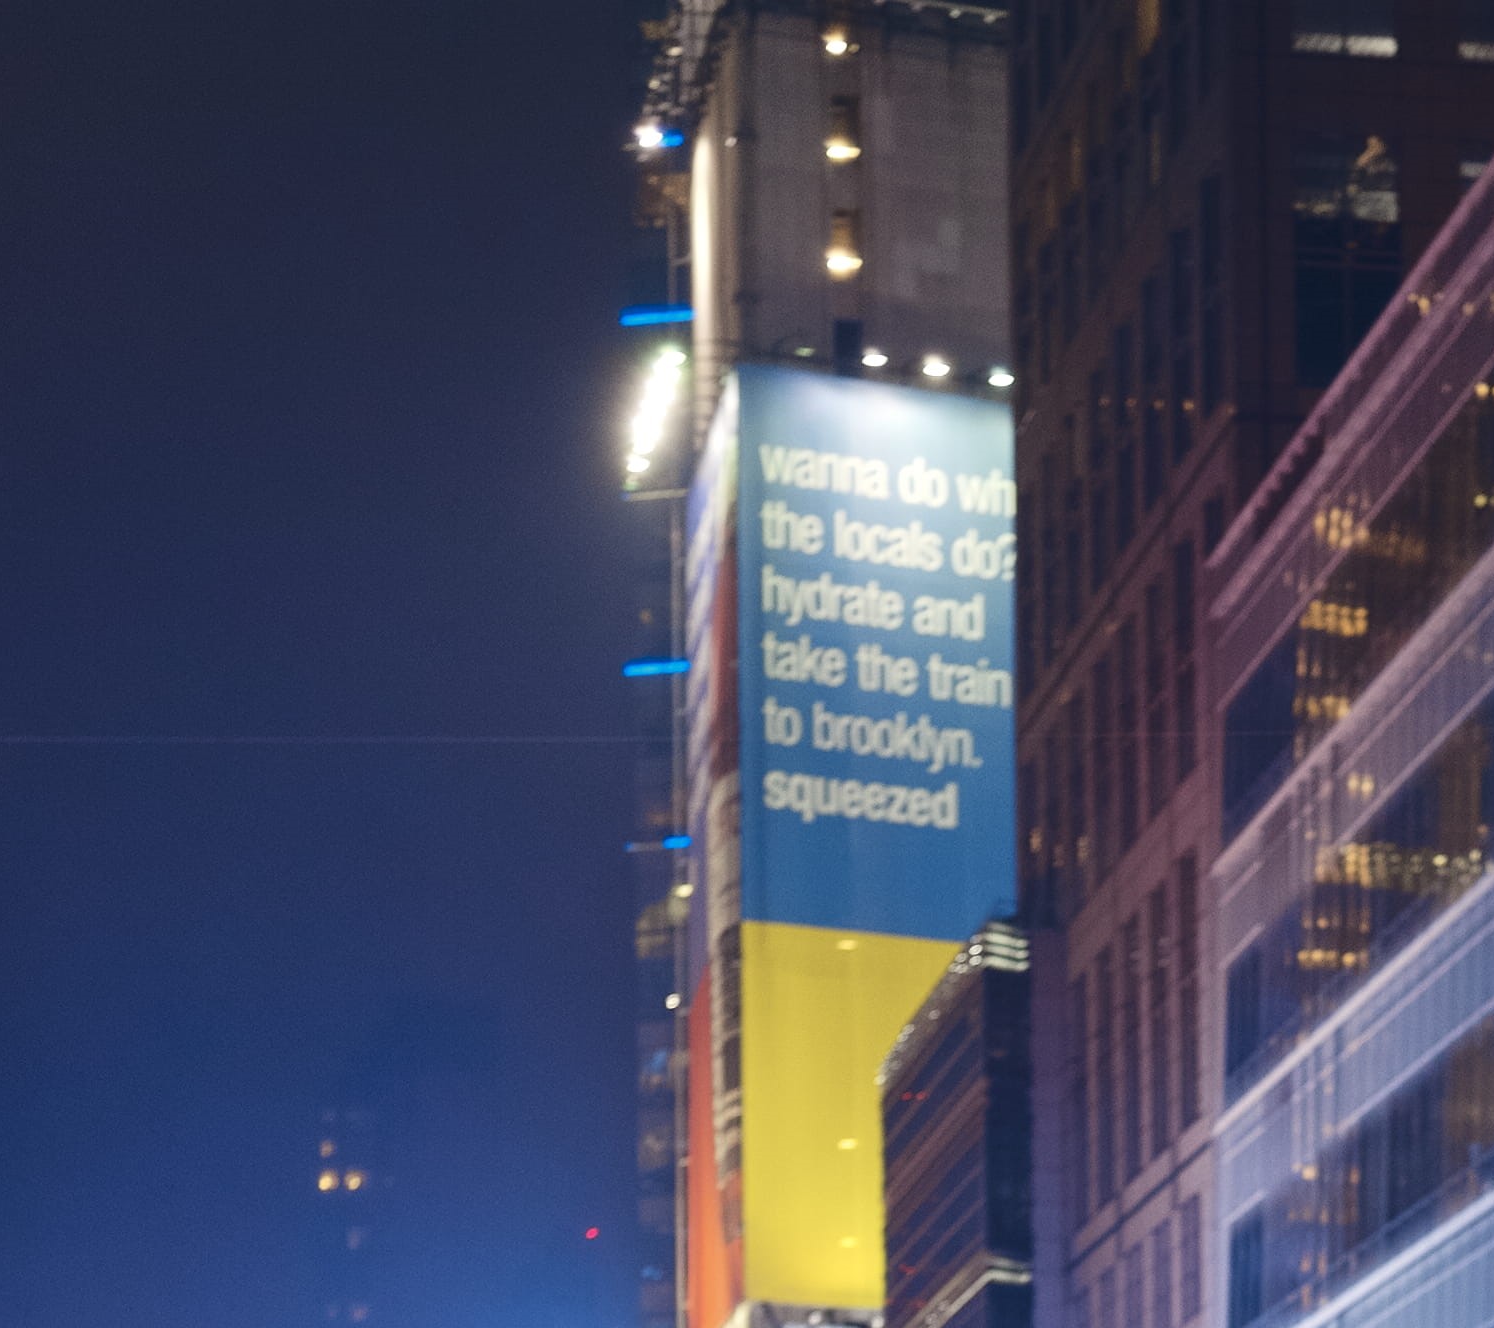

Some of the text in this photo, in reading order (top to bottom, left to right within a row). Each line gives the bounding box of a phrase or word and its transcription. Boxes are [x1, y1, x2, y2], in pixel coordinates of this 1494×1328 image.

[760, 445, 890, 500] wanna
[898, 457, 949, 508] do
[761, 502, 824, 555] the
[833, 511, 943, 572] locals
[762, 565, 986, 641] hydrate and
[762, 632, 1014, 709] take the train
[762, 698, 983, 774] to brooklyn.
[763, 770, 959, 830] squeezed
